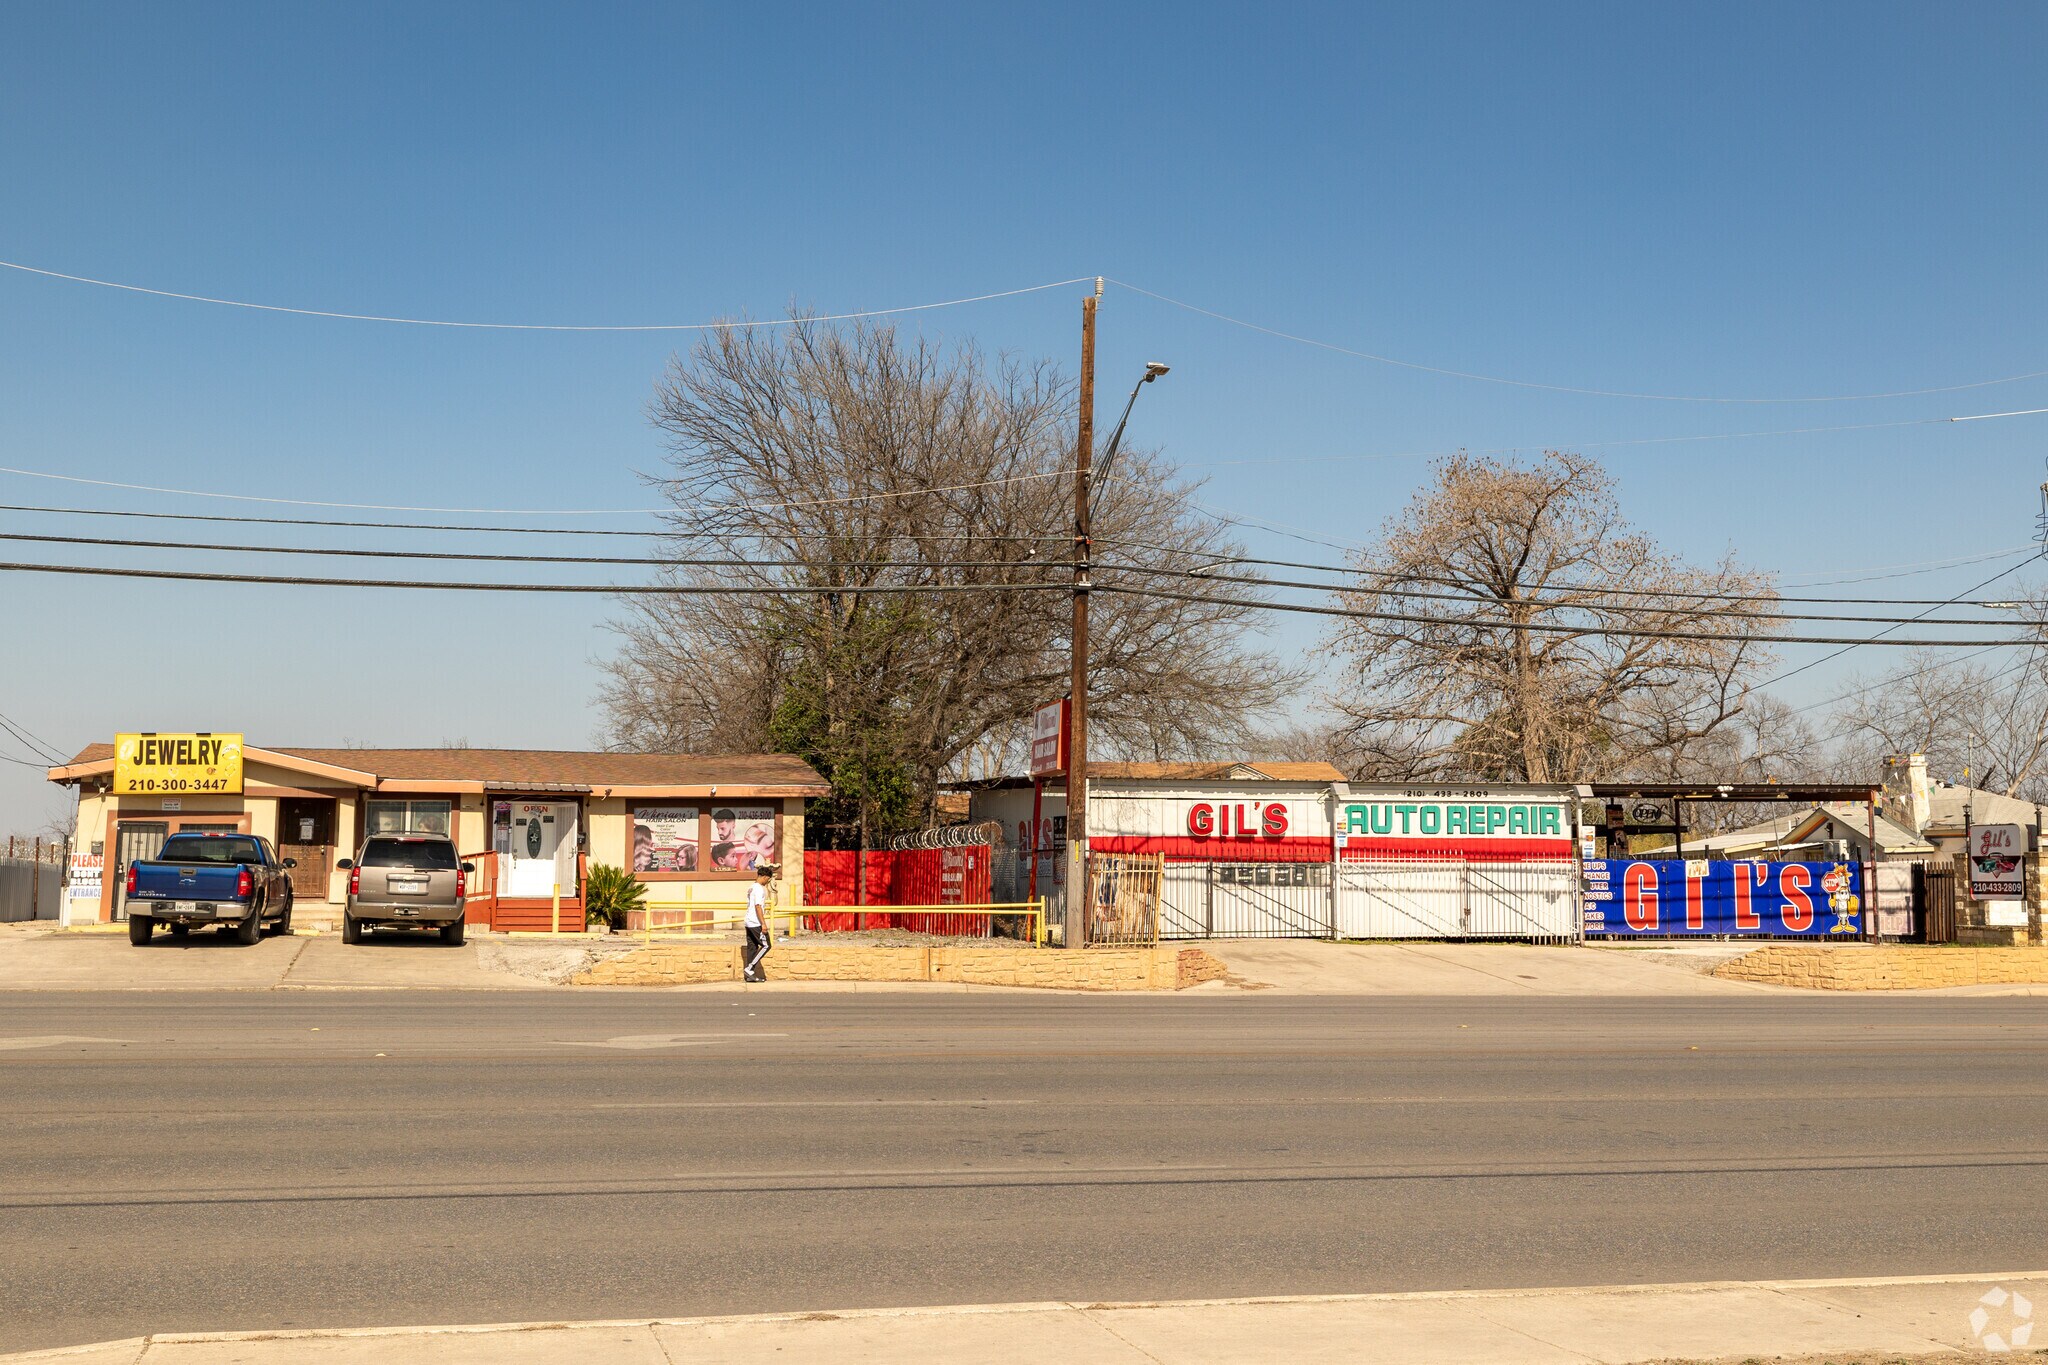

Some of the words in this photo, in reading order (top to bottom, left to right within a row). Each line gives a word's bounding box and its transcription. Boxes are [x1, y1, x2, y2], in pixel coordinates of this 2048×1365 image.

[133, 739, 222, 766] JEWELRY
[128, 779, 228, 791] 210-300-3447
[1403, 789, 1425, 798] (210)
[1434, 789, 1451, 798] 433
[1463, 789, 1489, 798] 2809
[524, 805, 549, 813] OPEN
[1188, 801, 1289, 836] GIL'S
[1344, 804, 1441, 834] AUTO
[1447, 804, 1561, 834] REPAIR
[1980, 829, 2011, 855] Gil's
[71, 854, 104, 868] PLEASE
[1592, 862, 1607, 871] UPS
[69, 887, 101, 898] ENTRANCE
[1973, 883, 2022, 892] 210-433-2809
[1623, 862, 1814, 932] GIL'S
